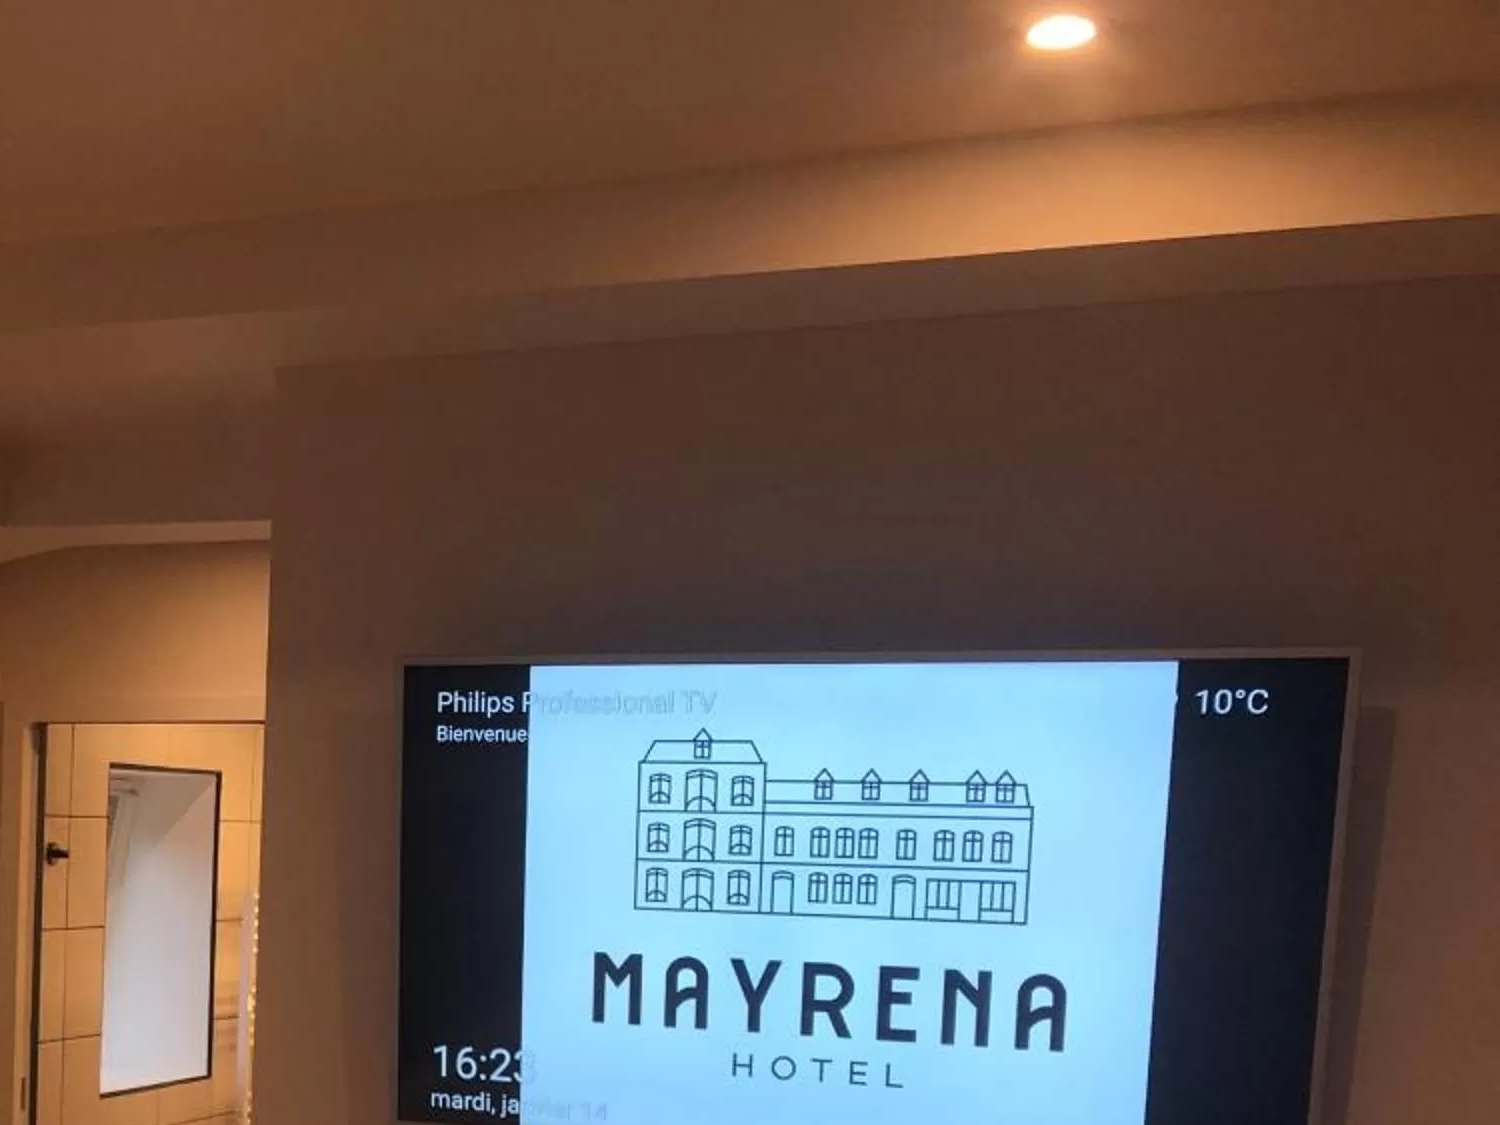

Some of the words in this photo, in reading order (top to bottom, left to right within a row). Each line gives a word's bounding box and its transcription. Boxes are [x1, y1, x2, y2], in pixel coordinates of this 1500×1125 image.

[437, 691, 514, 718] Philips
[680, 688, 718, 714] TV
[1195, 688, 1269, 715] 10°C
[436, 725, 528, 743] Bienvenue
[592, 951, 1067, 1052] MAYRENA
[433, 1045, 537, 1084] 16:23
[731, 1052, 904, 1089] HOTEL
[430, 1091, 496, 1115] mardi,
